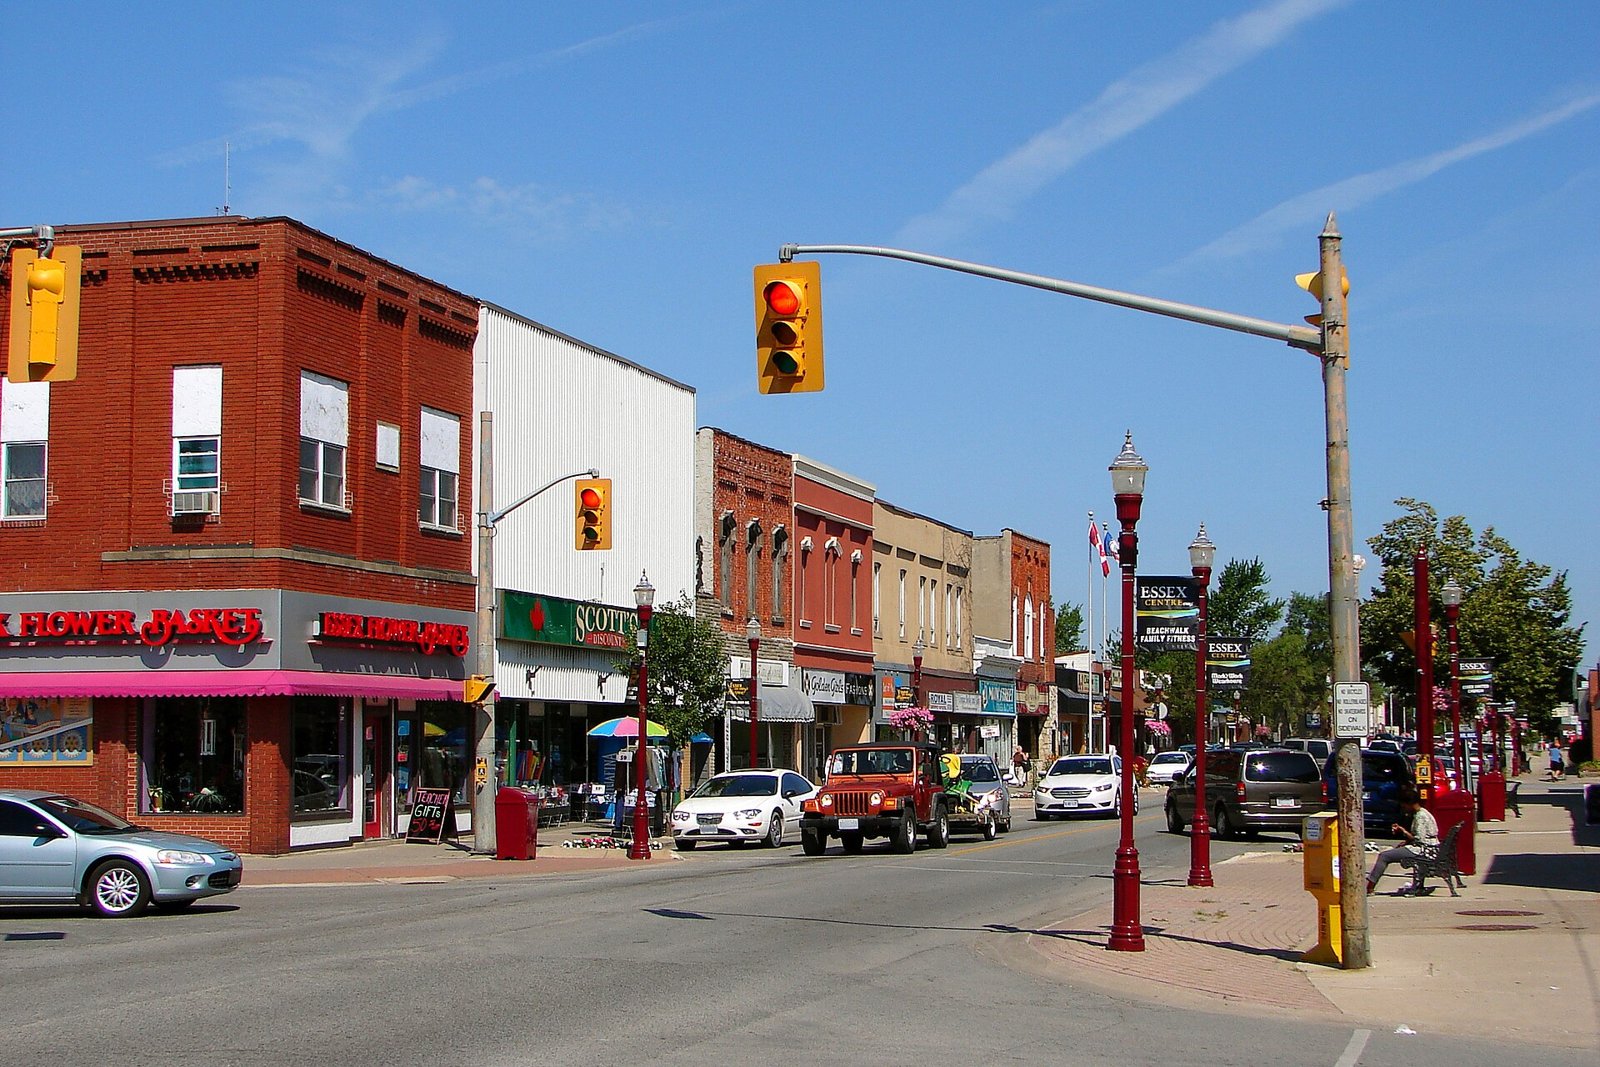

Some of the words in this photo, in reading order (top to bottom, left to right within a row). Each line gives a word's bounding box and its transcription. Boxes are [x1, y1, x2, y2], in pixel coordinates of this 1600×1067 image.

[1140, 586, 1188, 599] ESSEX
[20, 610, 137, 637] FLOWER
[140, 608, 262, 646] BASKET
[1146, 627, 1190, 635] BEACHWALK
[322, 612, 364, 638] ESSEX
[366, 616, 419, 642] FLOWER
[418, 621, 470, 657] BASKET
[593, 633, 622, 647] DISCOUNT
[1140, 635, 1166, 643] FAMILY
[1166, 635, 1196, 643] FITNESS
[1208, 643, 1243, 653] ESSEX
[1459, 662, 1487, 671] ESSEX
[811, 676, 830, 695] Golden
[831, 678, 844, 696] Girls
